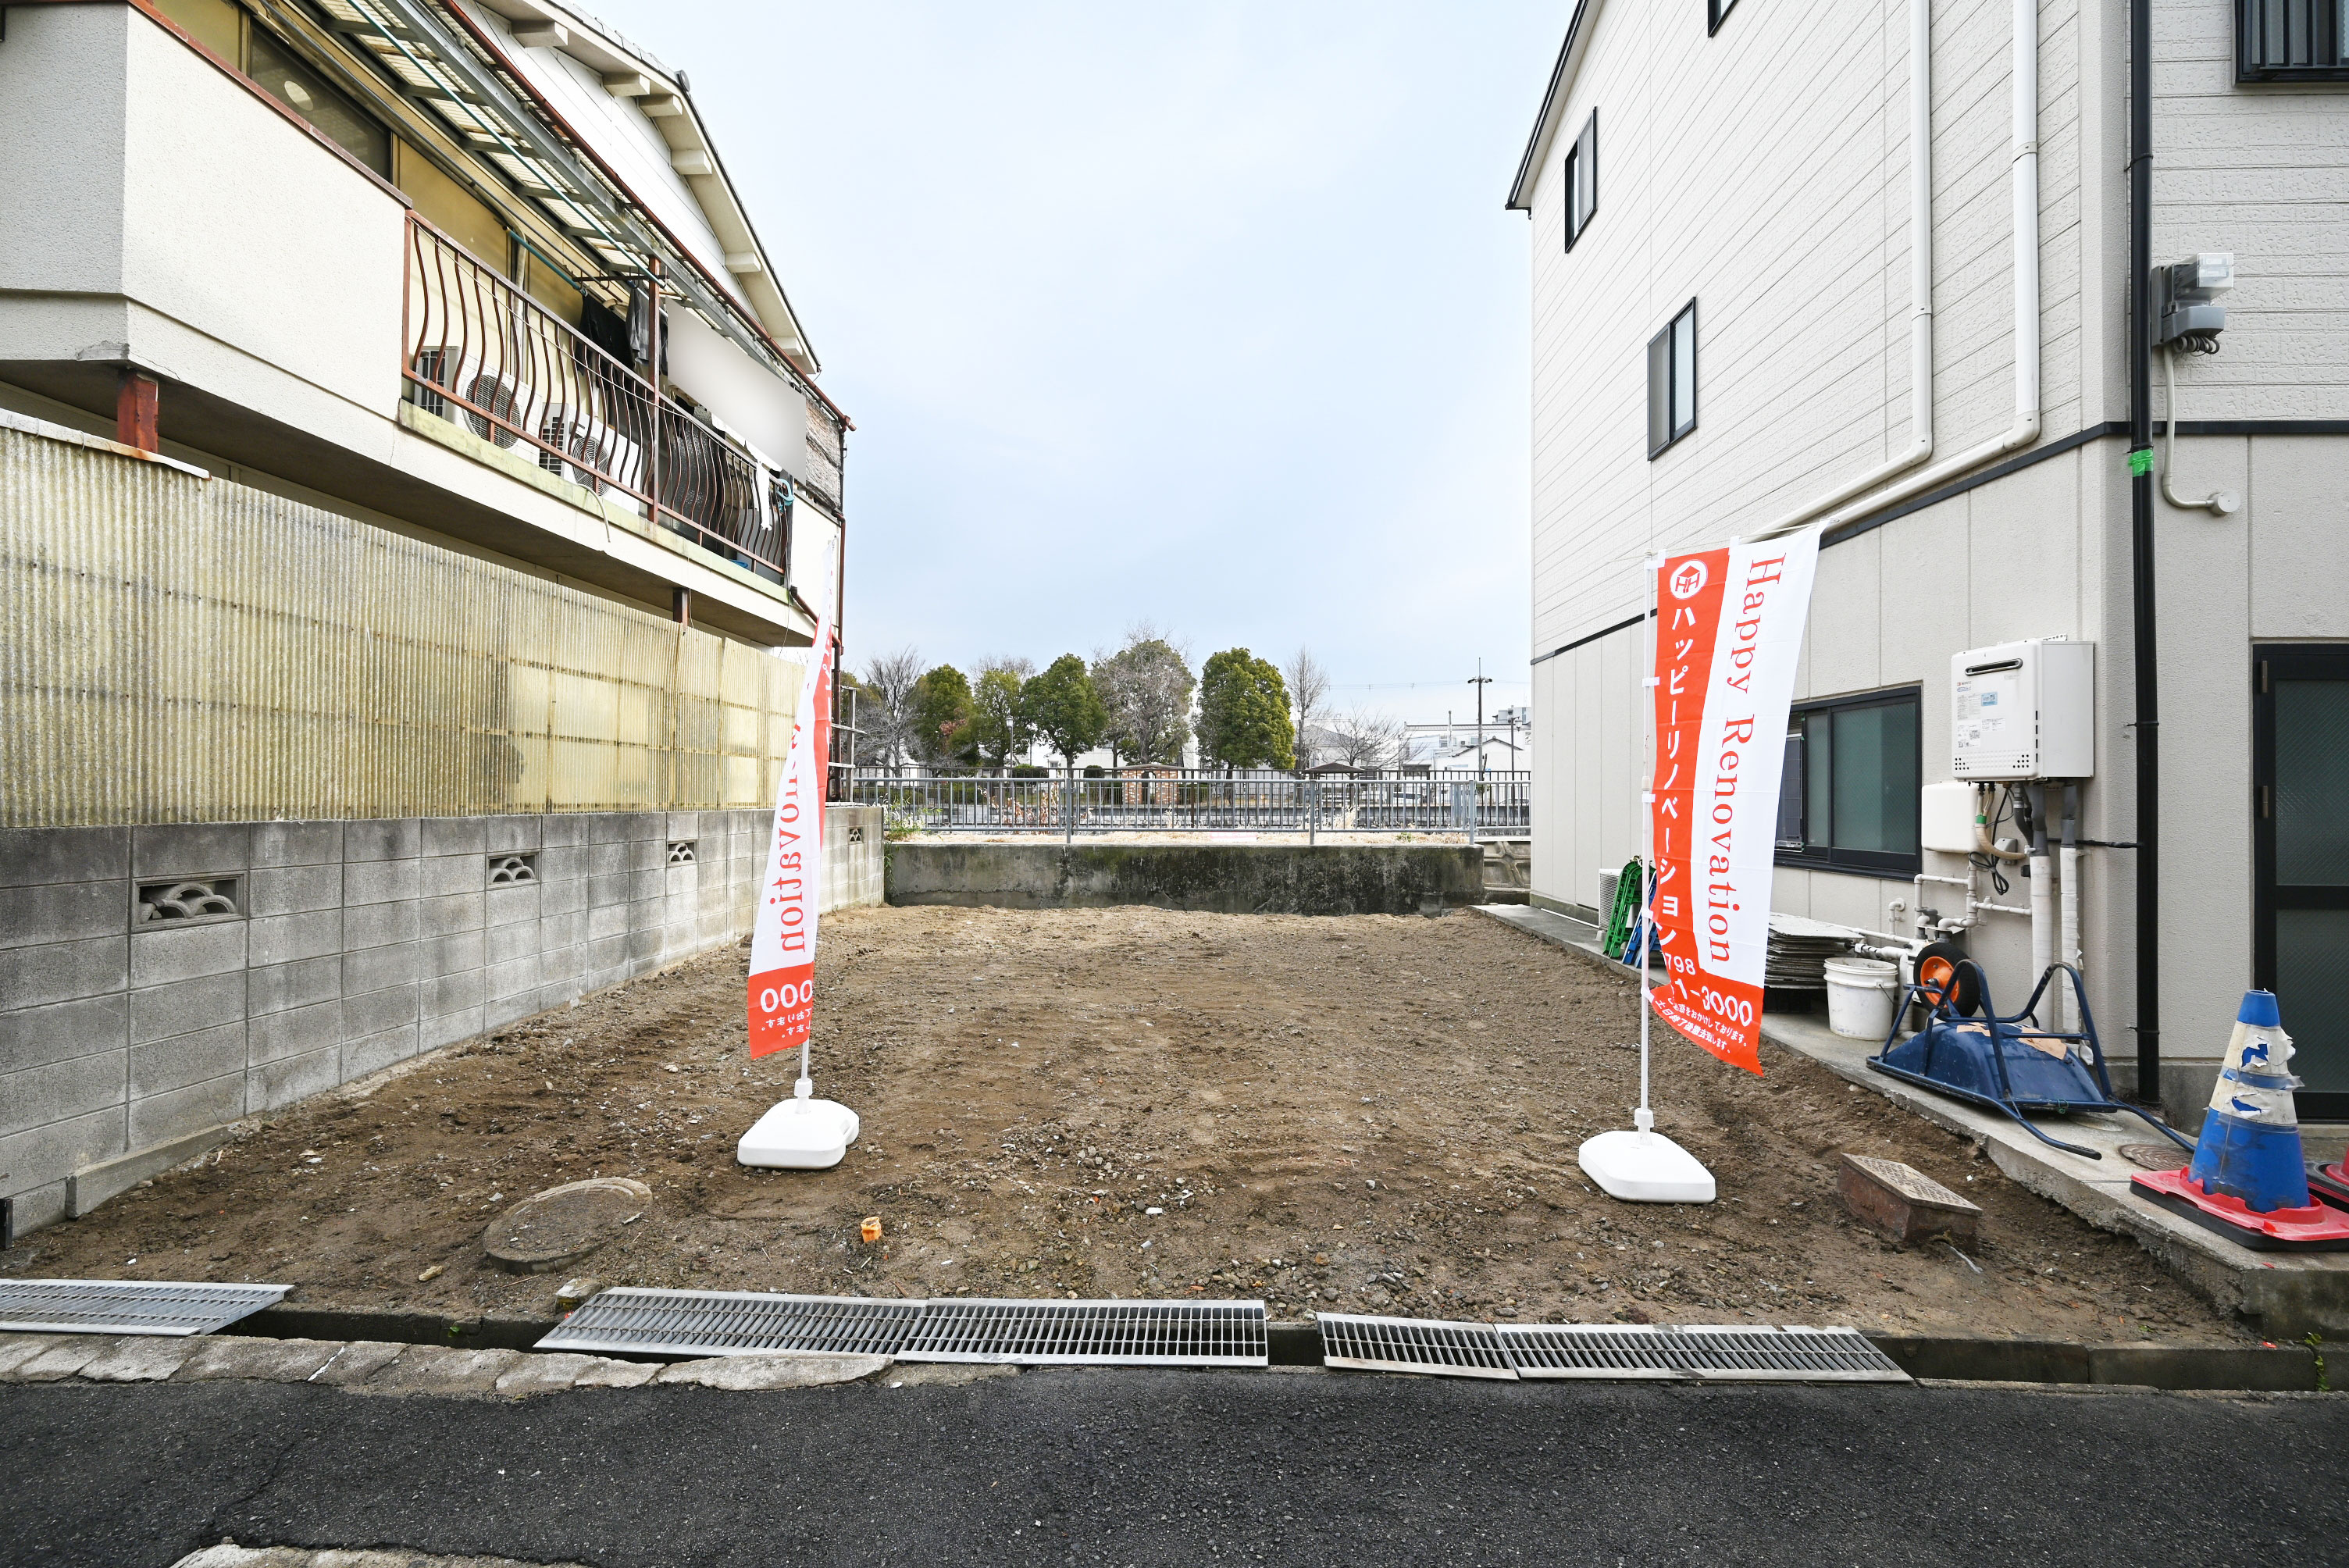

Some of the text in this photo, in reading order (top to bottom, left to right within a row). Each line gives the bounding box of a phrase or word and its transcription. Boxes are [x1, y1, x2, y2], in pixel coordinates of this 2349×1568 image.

[1656, 606, 1696, 946] ハッピーリノベーション
[1708, 551, 1787, 963] Happy Renovation
[1663, 952, 1696, 975] 798
[1671, 978, 1753, 1028] 1-3000
